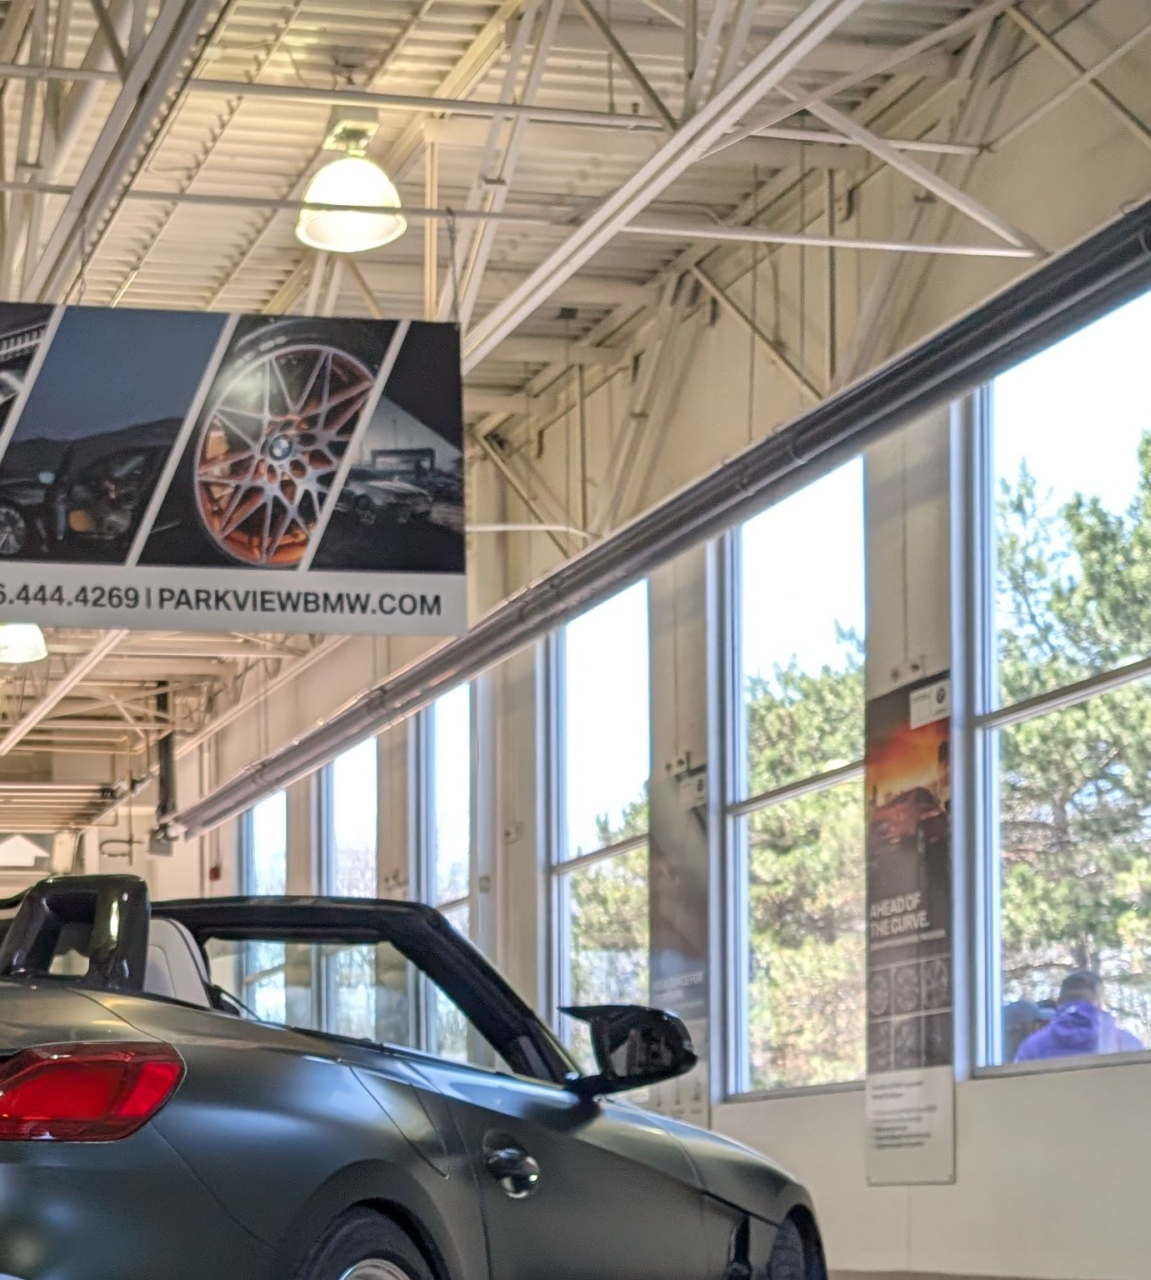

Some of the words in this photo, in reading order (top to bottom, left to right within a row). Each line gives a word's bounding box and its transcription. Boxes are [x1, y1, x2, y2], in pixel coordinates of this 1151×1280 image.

[158, 587, 443, 616] PARKVIEWBMW.COM
[870, 895, 905, 919] AHEAD
[905, 891, 922, 912] OF
[870, 918, 891, 938] THE
